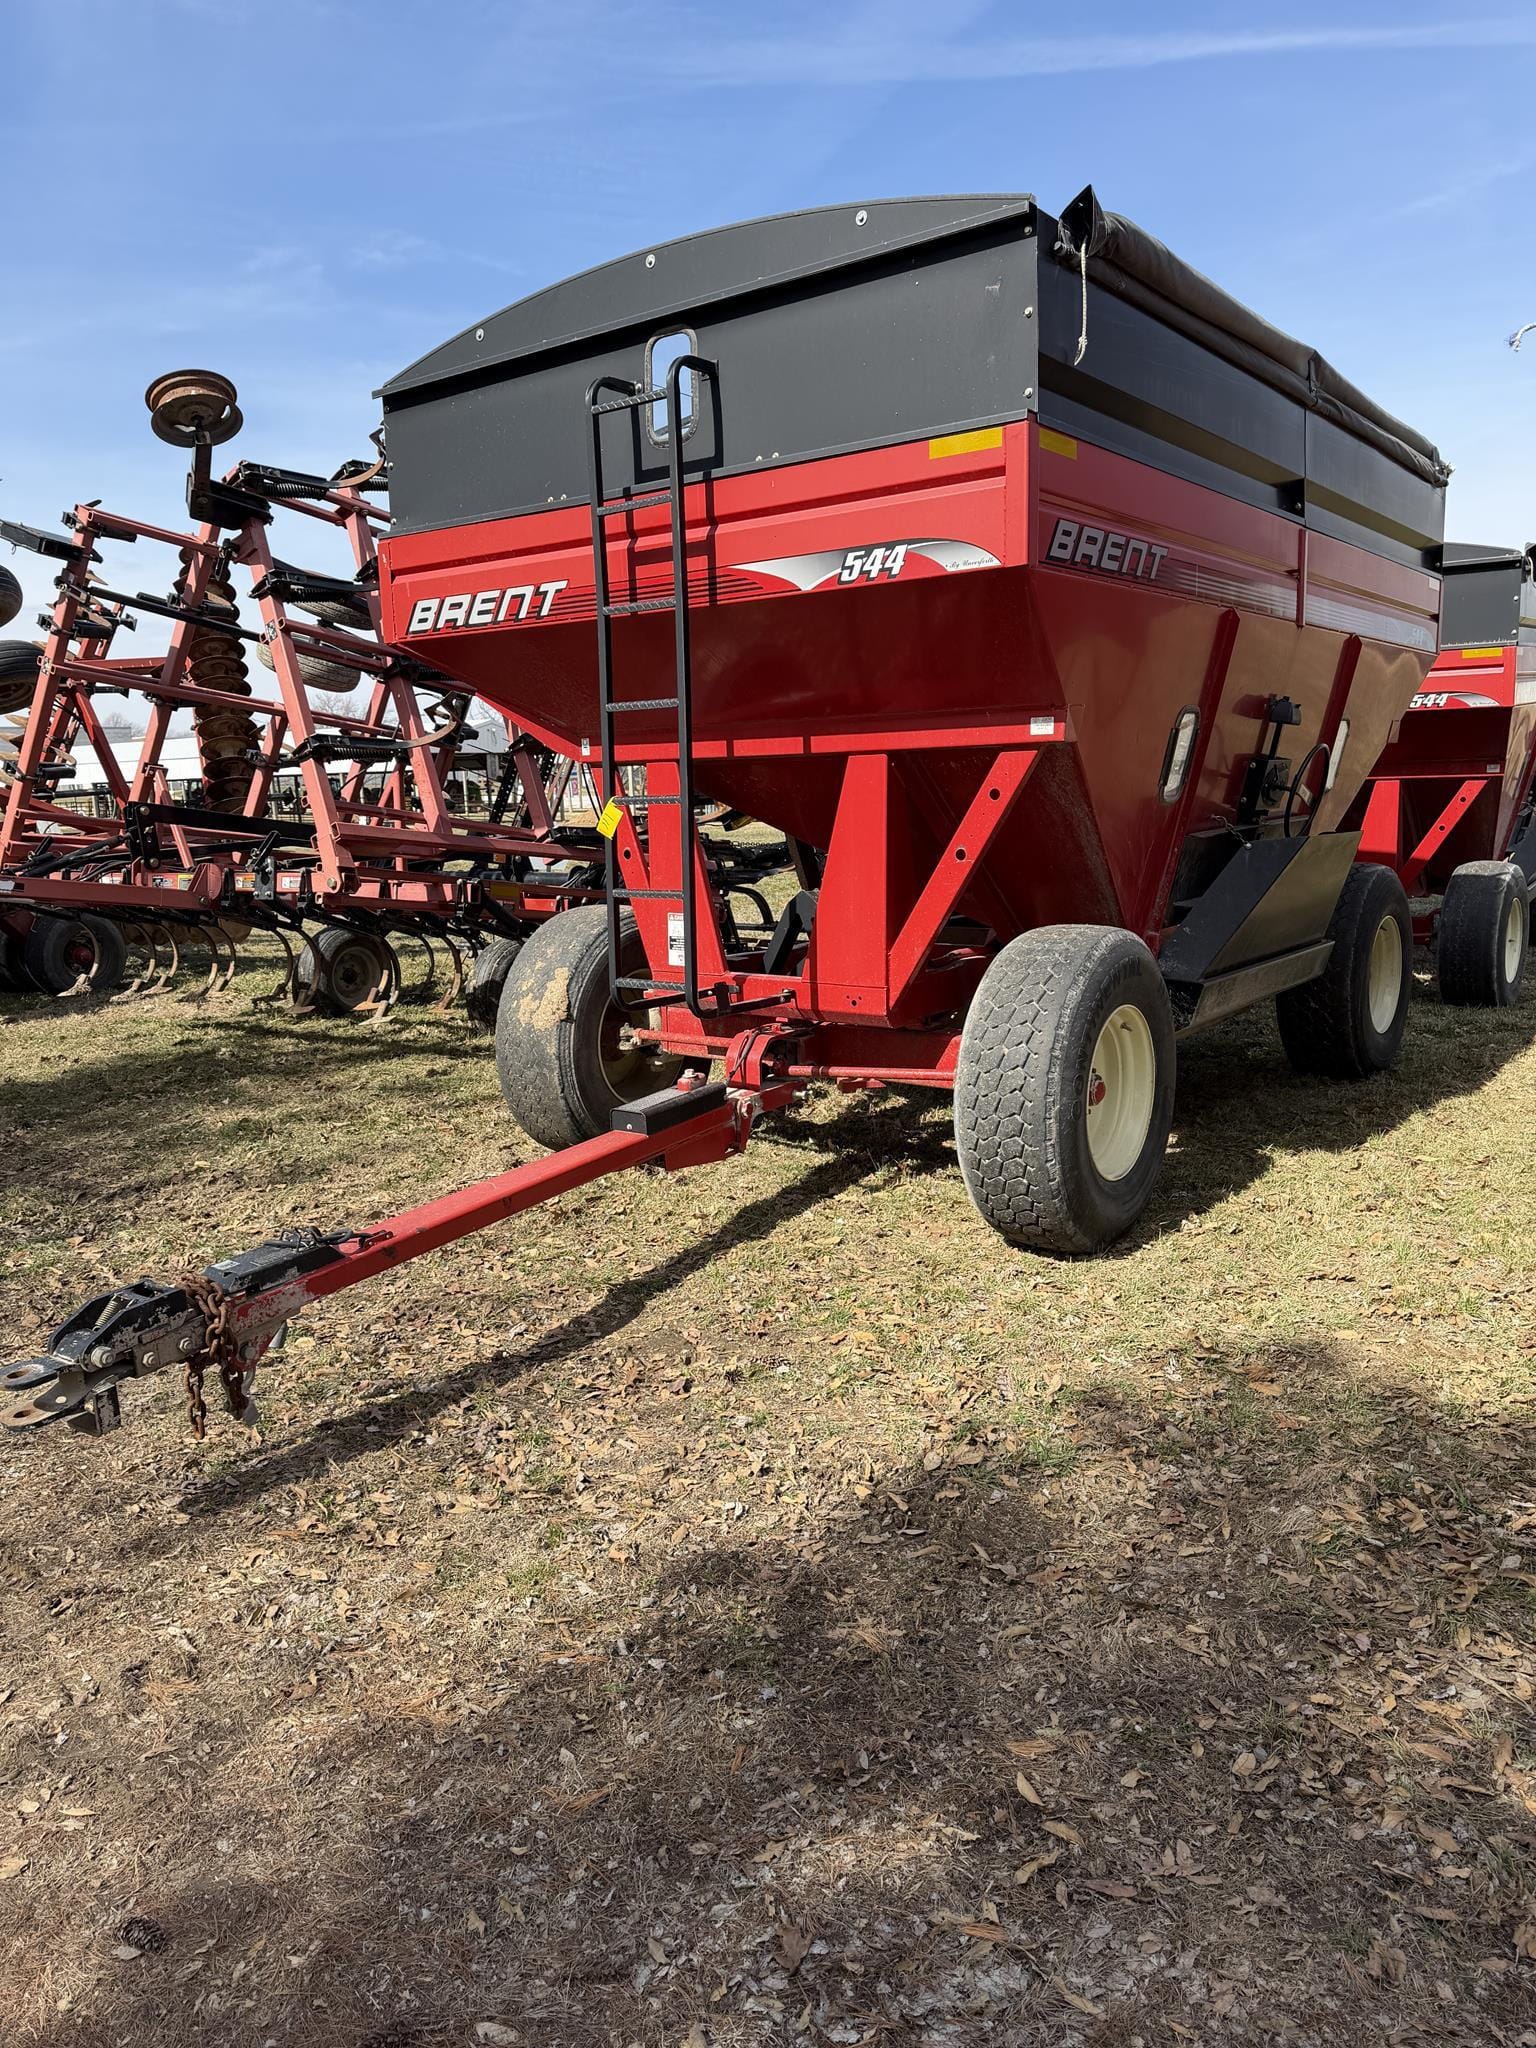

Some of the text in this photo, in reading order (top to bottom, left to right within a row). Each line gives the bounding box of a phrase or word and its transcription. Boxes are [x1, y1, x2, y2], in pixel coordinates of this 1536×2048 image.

[838, 544, 908, 583] 544
[1048, 518, 1168, 581] BRENT
[407, 579, 569, 634] BRENT
[1408, 693, 1449, 709] 544
